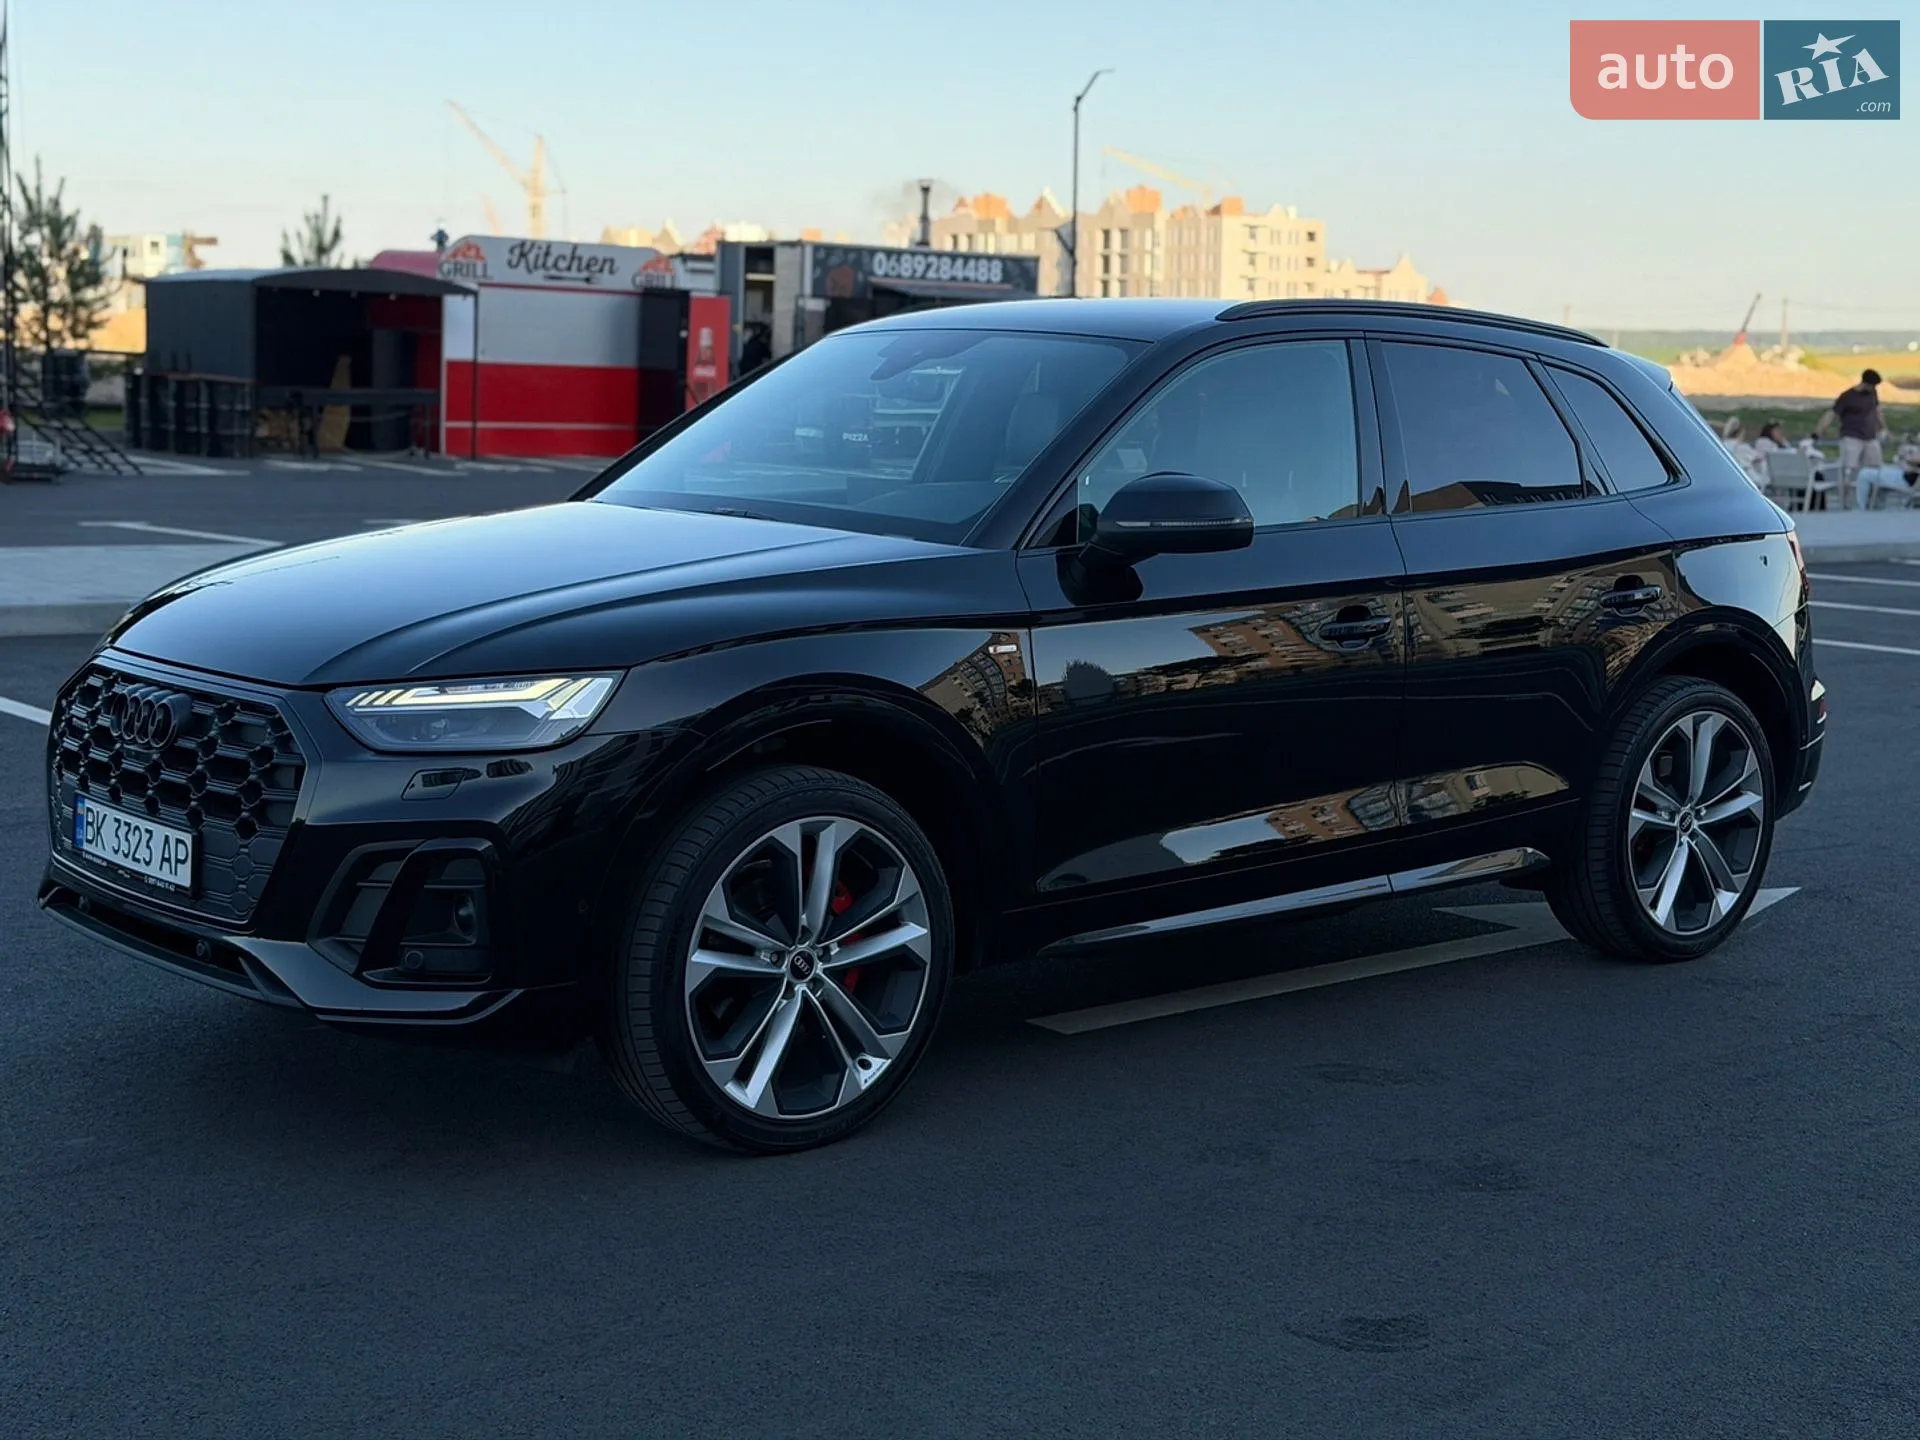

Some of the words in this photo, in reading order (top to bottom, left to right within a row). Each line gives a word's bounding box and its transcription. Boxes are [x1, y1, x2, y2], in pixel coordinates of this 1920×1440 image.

[438, 260, 493, 281] GRILL
[506, 240, 619, 275] Kitchen
[871, 251, 1004, 283] 0689284488
[85, 807, 108, 851] BK
[112, 817, 153, 866] 3323
[159, 835, 190, 876] AP
